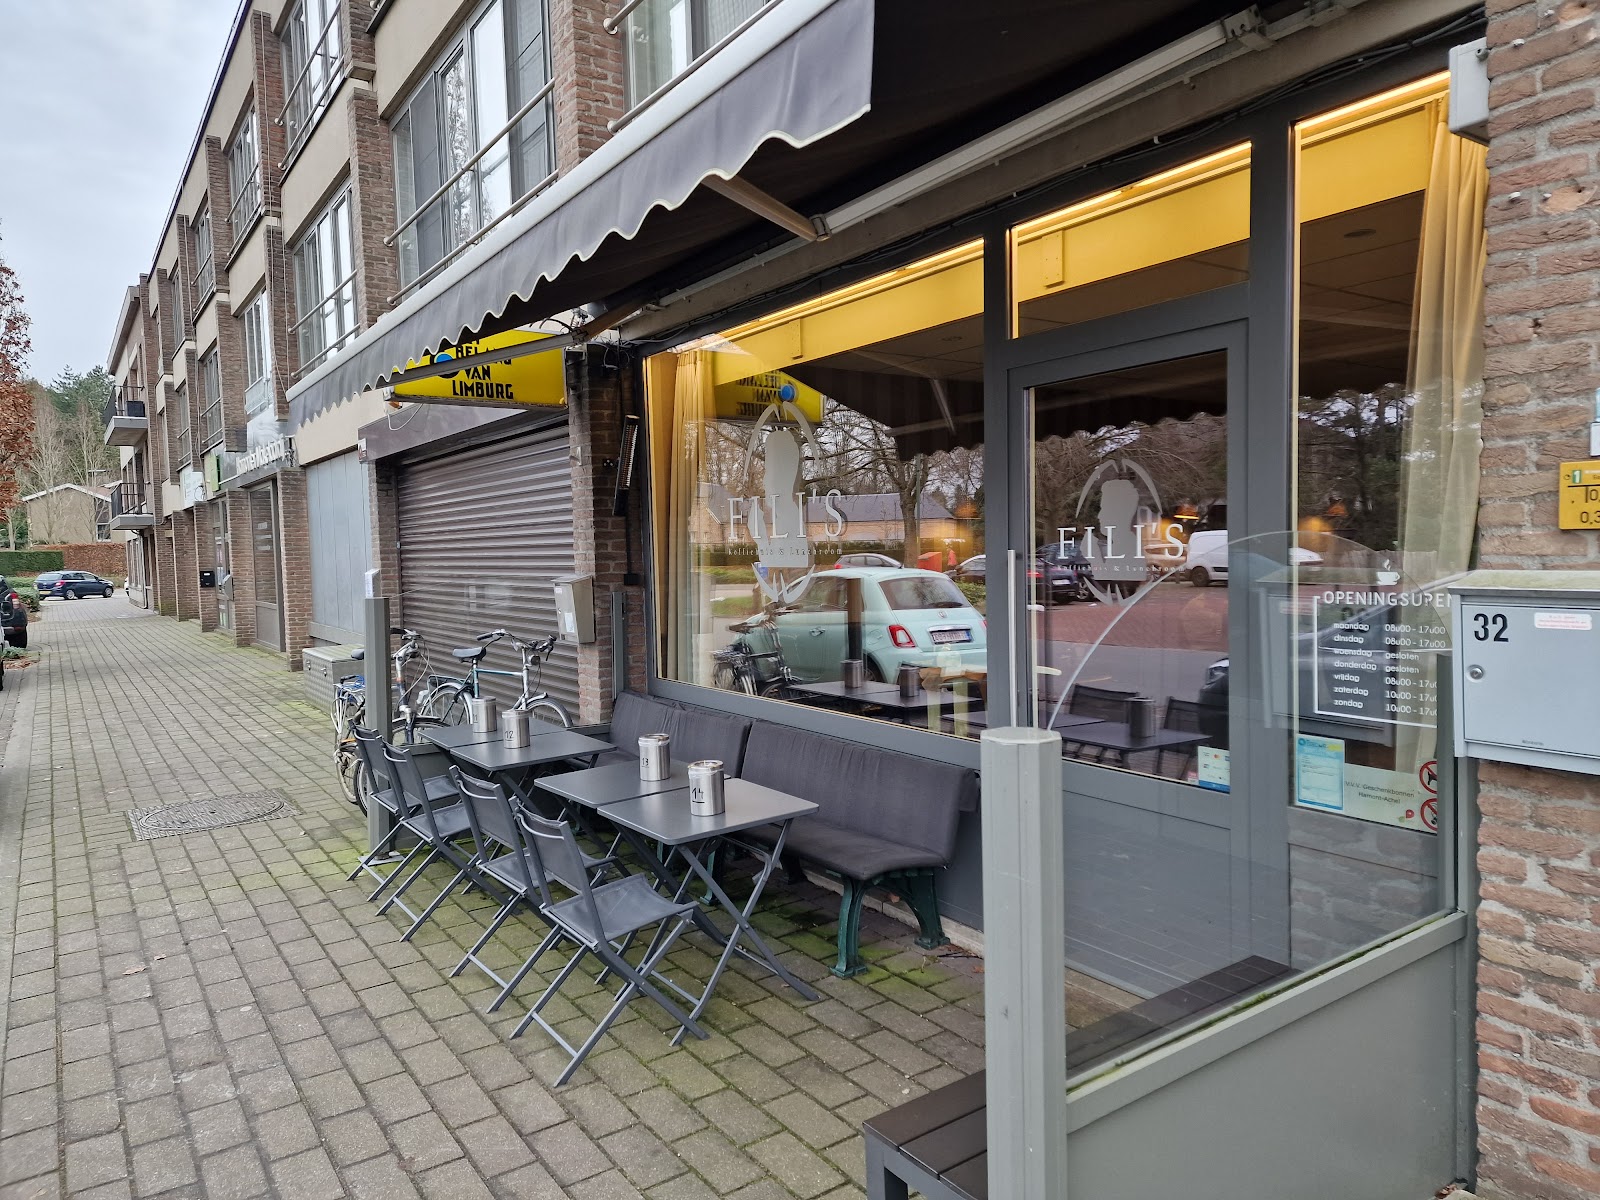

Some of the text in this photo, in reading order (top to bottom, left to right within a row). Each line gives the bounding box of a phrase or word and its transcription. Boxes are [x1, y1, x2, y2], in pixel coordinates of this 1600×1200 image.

[464, 366, 491, 381] VAN
[452, 379, 514, 400] LIMBURG
[727, 488, 843, 538] FILI'S
[1057, 523, 1184, 559] FILI'S
[1333, 622, 1369, 632] maandag
[1384, 624, 1411, 633] 08u00
[1418, 625, 1446, 635] 17u00
[1473, 613, 1509, 642] 32
[1333, 634, 1364, 644] dinsdag
[1385, 636, 1411, 646] 08u00
[1418, 639, 1446, 649] 17u00
[1385, 652, 1419, 661] gesloten
[1334, 660, 1420, 674] donderdag gesloten
[1334, 673, 1360, 682] vrijdag
[1385, 677, 1411, 686] 08u00
[1333, 686, 1369, 696] zaterdag
[1333, 699, 1363, 709] zondag
[504, 730, 514, 739] 12
[691, 787, 704, 800] 14
[1363, 783, 1415, 798] Geschenkbonnen
